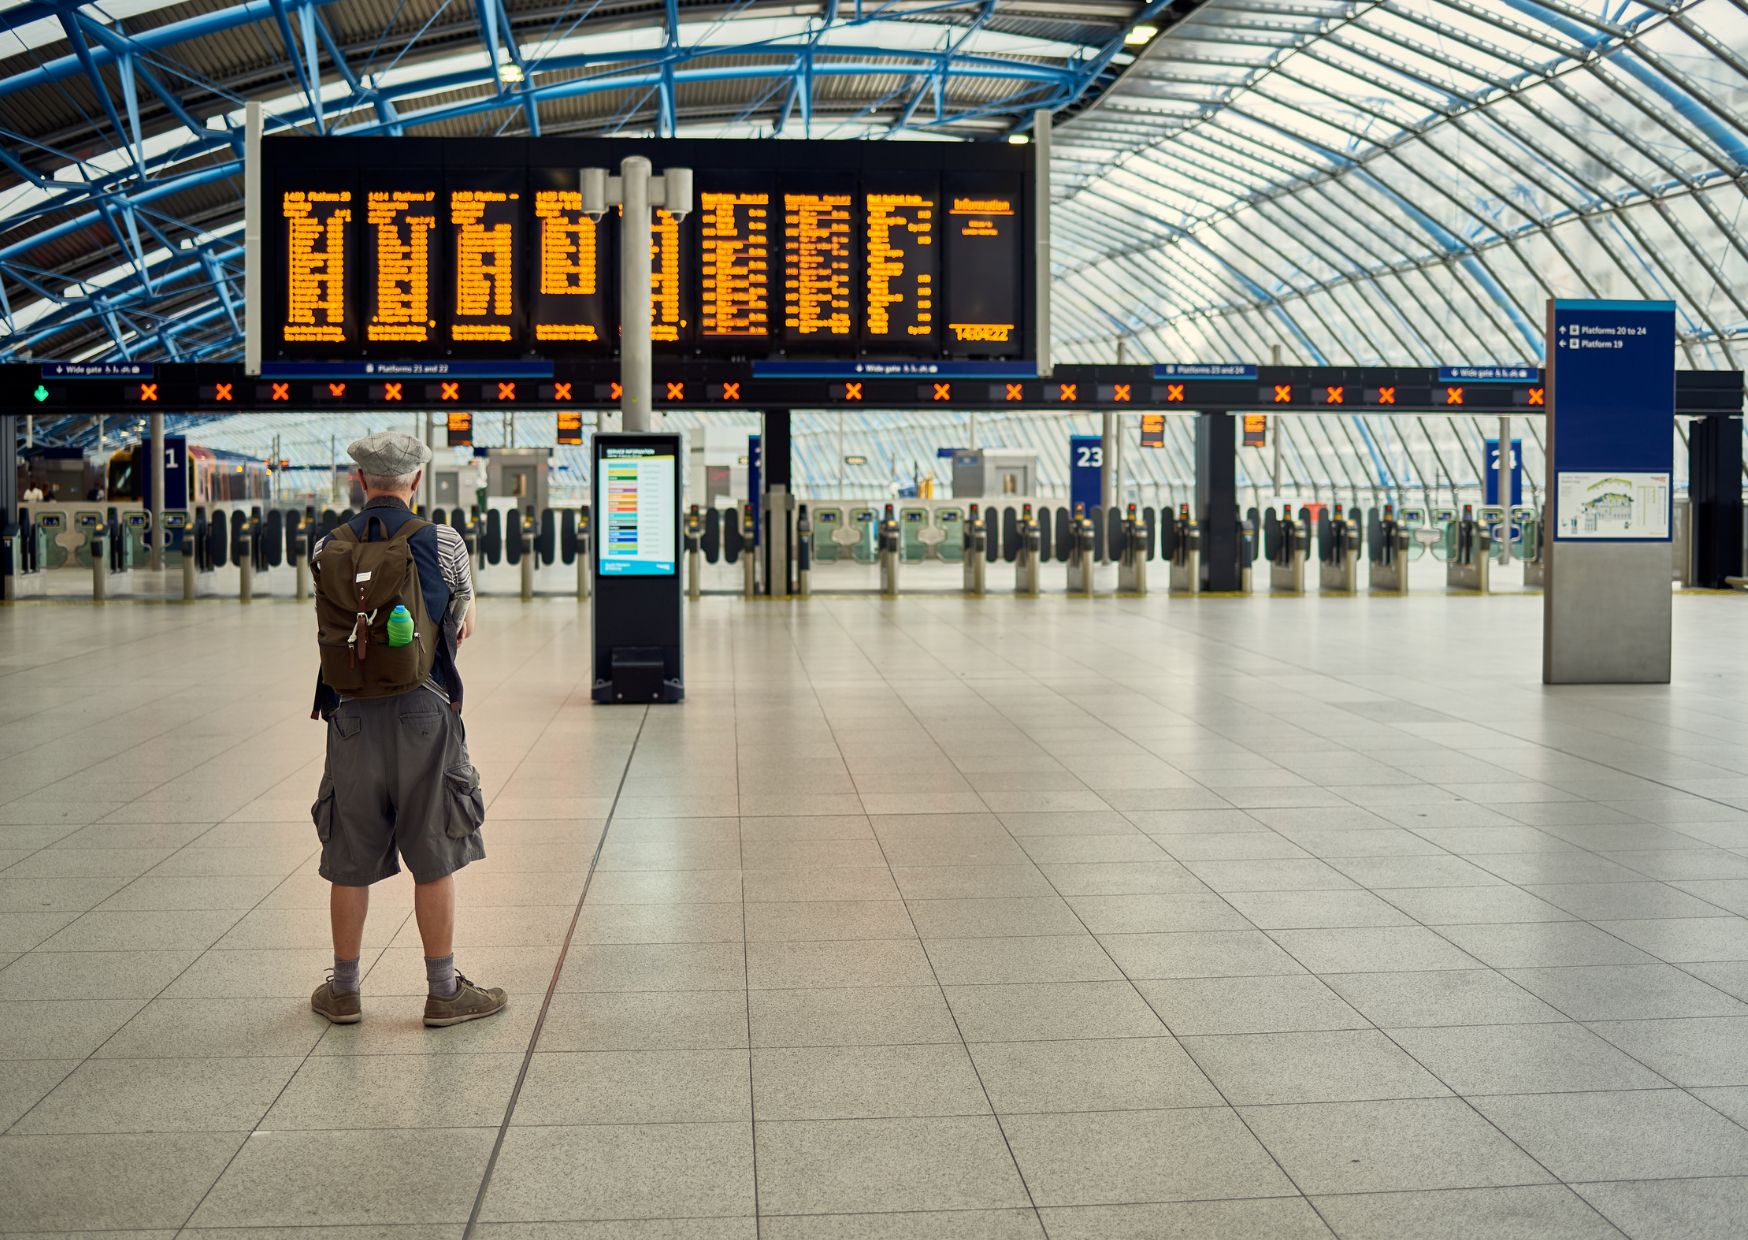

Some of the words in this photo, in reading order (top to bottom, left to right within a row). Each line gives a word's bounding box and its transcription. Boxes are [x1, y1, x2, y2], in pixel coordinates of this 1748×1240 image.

[954, 198, 1010, 210] Information
[956, 327, 1008, 341] 14:04:22
[1581, 326, 1615, 335] Platforms
[1616, 326, 1627, 335] 20
[1627, 327, 1636, 335] to
[1636, 327, 1647, 335] 24
[1581, 339, 1612, 349] Platform
[1613, 340, 1623, 349] 19
[66, 365, 84, 374] Wide
[86, 366, 102, 375] gate
[378, 364, 412, 373] Platforms
[424, 364, 438, 373] and
[865, 364, 883, 373] Wide
[885, 365, 901, 374] gate
[1177, 365, 1210, 374] Platforms
[1221, 365, 1234, 374] and
[1459, 369, 1477, 377] Wide
[1477, 369, 1493, 378] gate
[1077, 446, 1104, 467] 23
